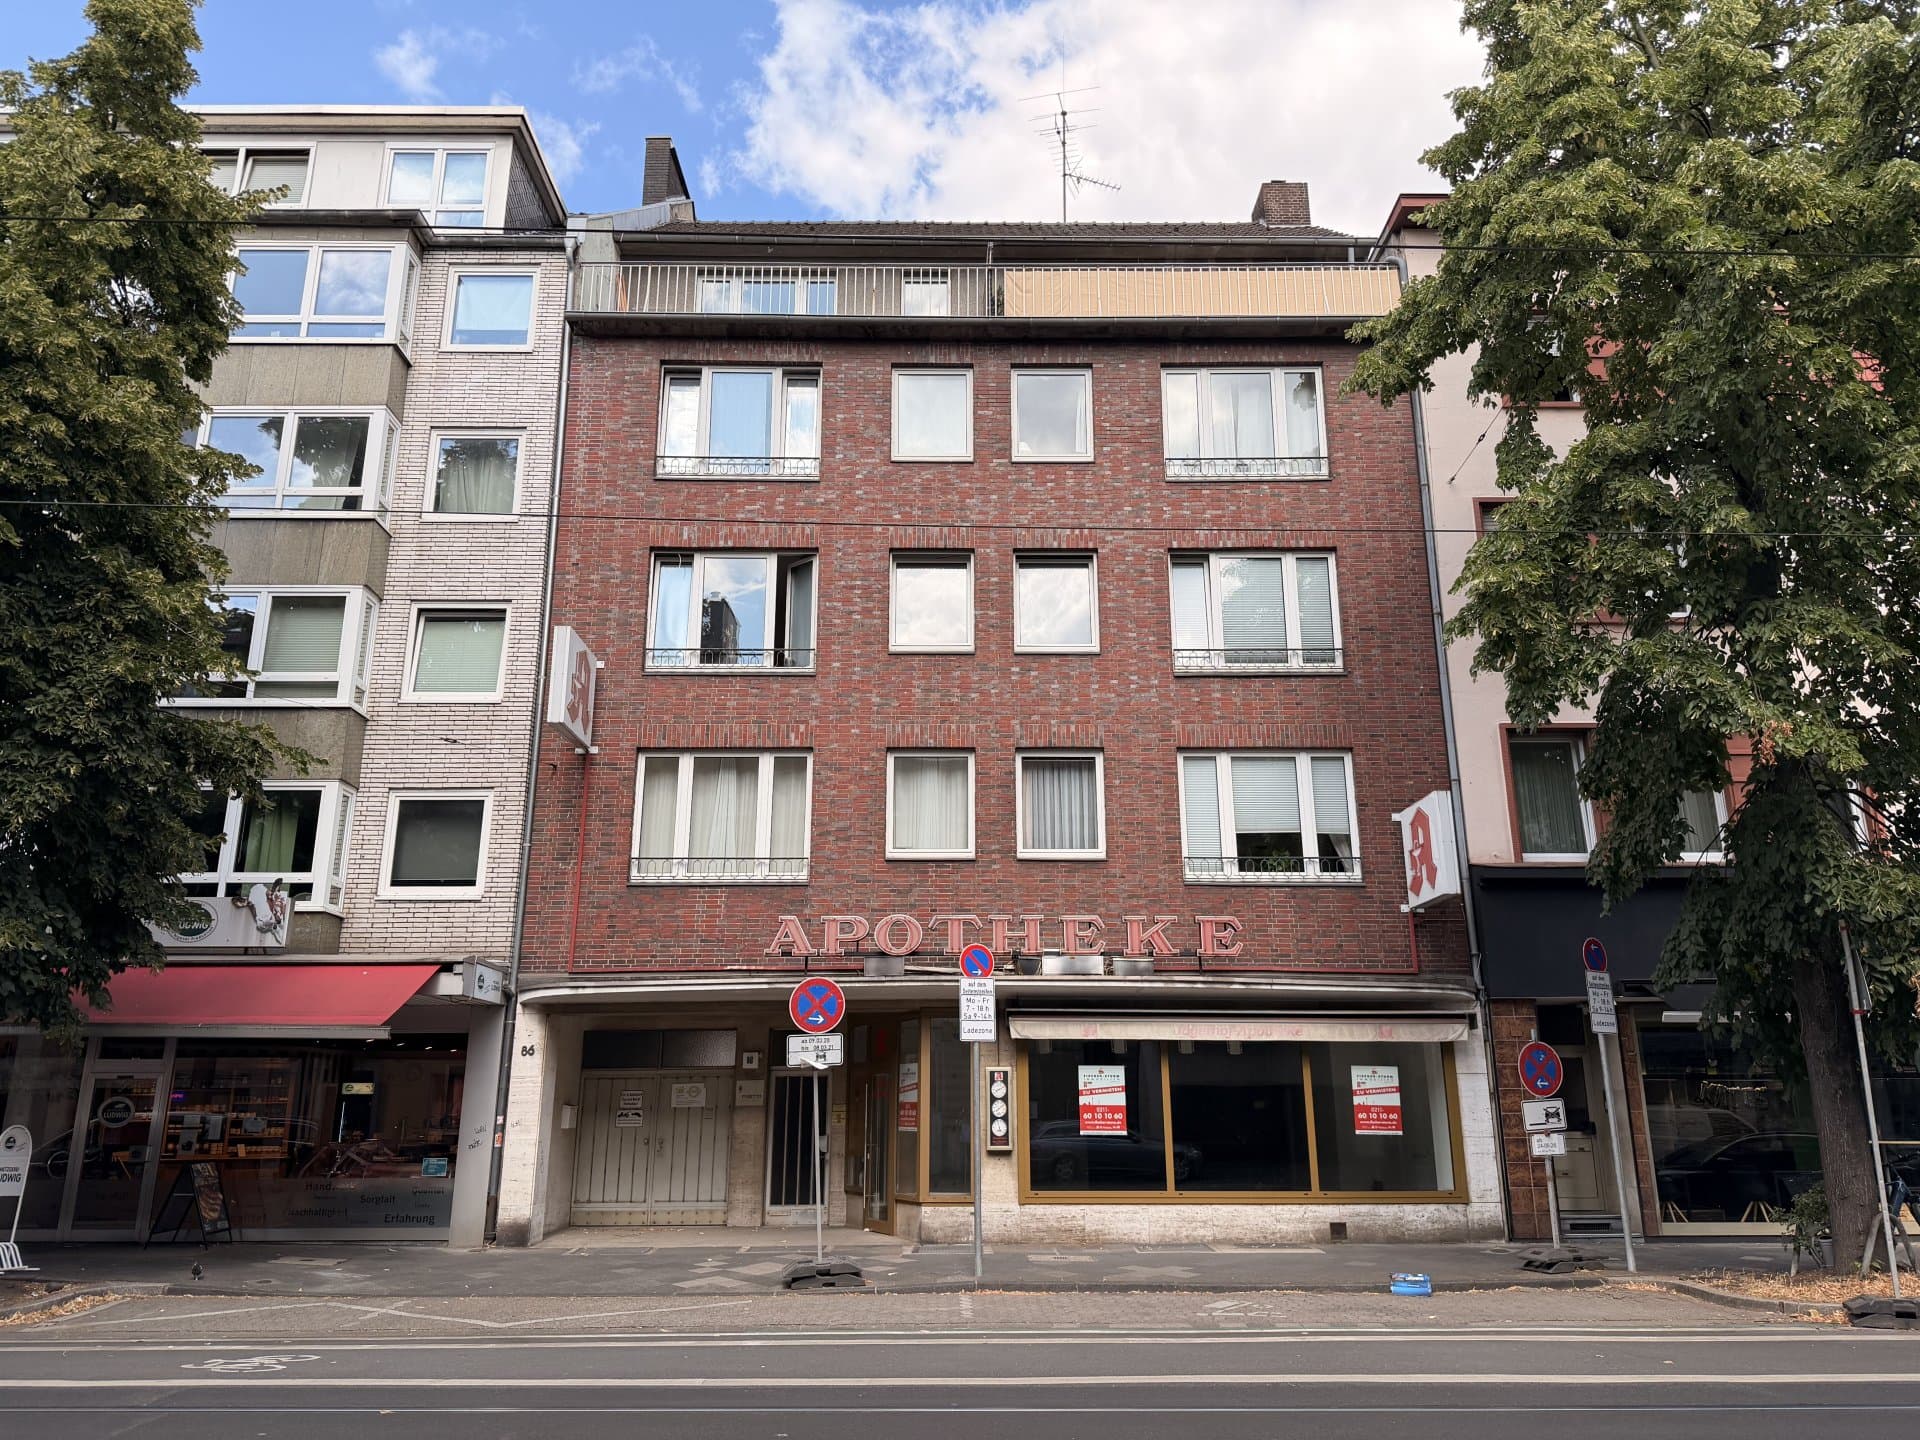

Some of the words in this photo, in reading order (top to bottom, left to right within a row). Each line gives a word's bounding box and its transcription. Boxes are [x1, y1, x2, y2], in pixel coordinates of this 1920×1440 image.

[763, 913, 1244, 957] APOTHEKE
[963, 1012, 972, 1020] Sa
[521, 1044, 535, 1057] 86
[1091, 1086, 1123, 1095] VERMIETEN
[1365, 1087, 1397, 1095] VERMIETEN
[103, 1111, 130, 1119] LUDWIG
[1114, 1112, 1123, 1120] 60
[0, 1173, 21, 1183] UDWIG
[359, 1193, 396, 1206] Sorgfalt
[384, 1213, 435, 1226] Erfahrung
